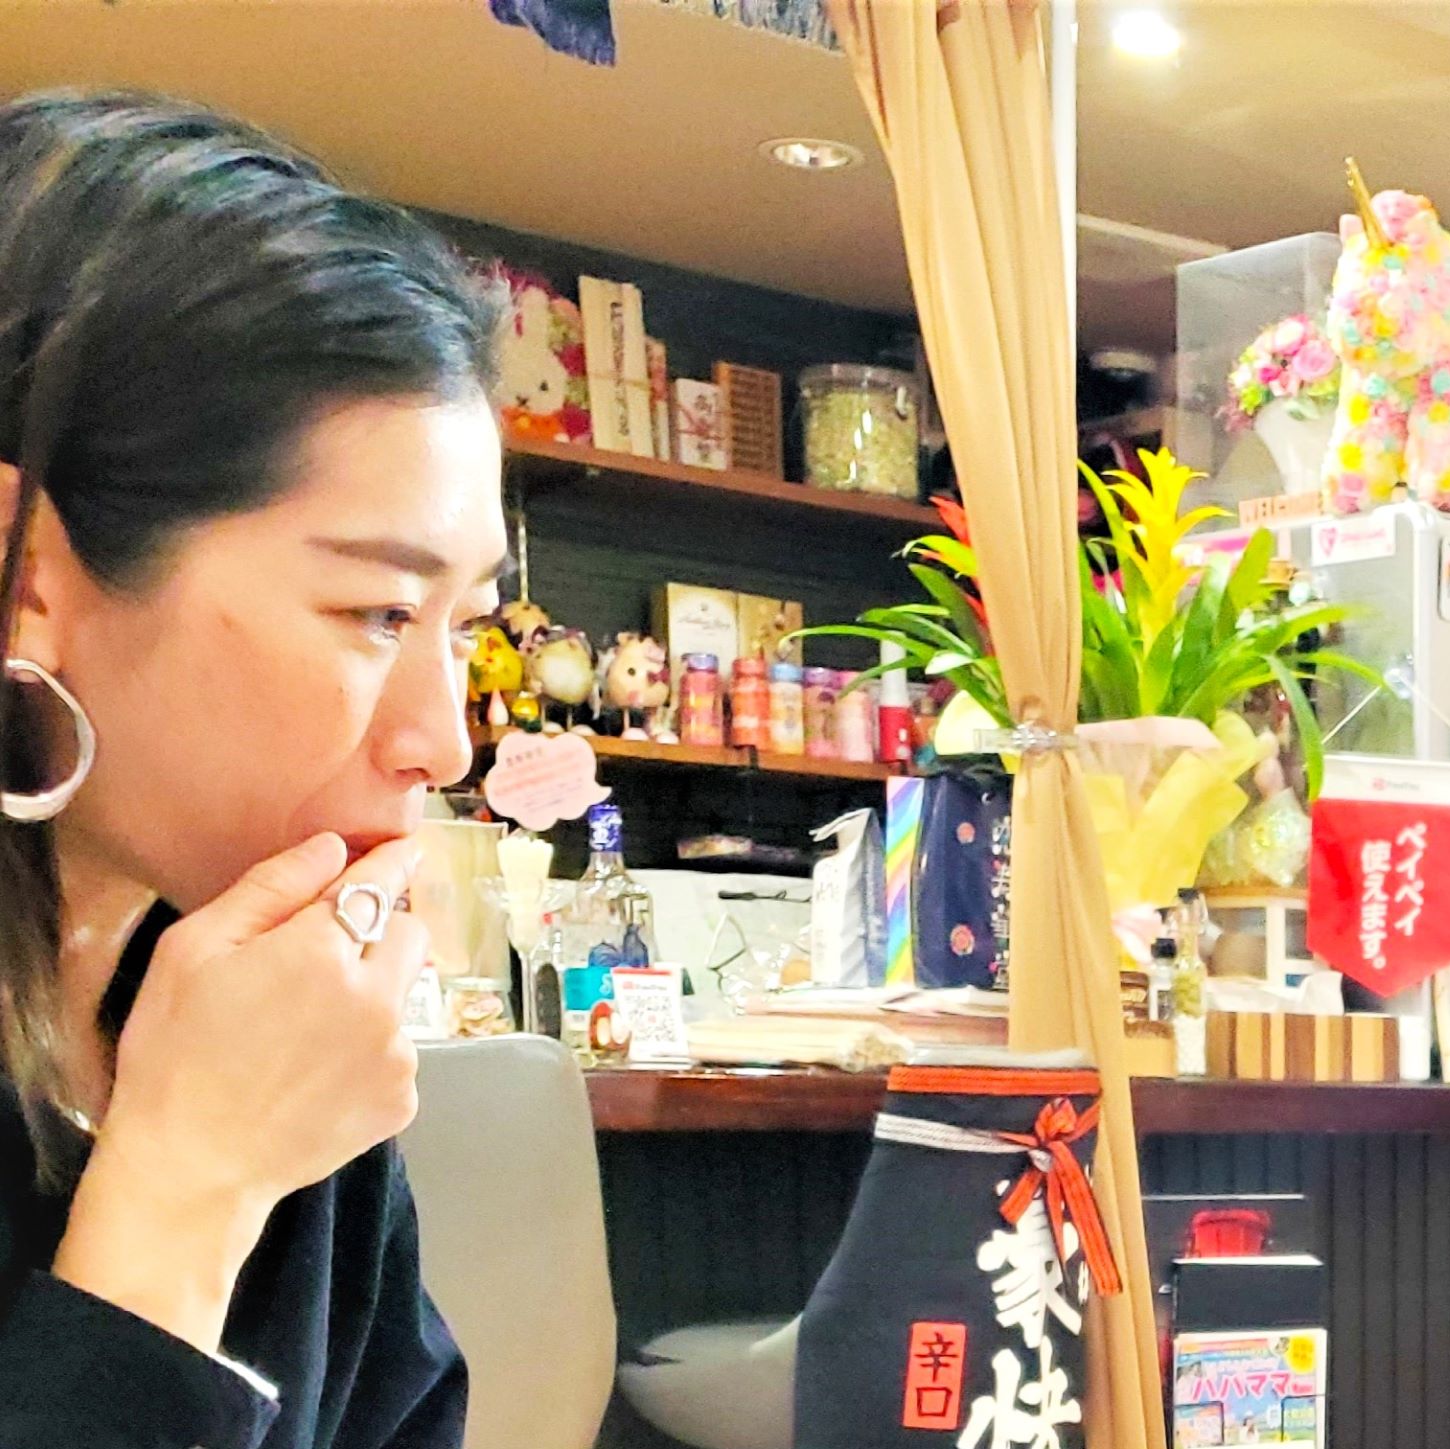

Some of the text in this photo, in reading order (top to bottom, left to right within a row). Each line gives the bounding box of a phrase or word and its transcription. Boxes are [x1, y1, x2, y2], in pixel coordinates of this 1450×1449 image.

[1359, 839, 1393, 970] 使えます。
[1394, 822, 1428, 937] ペイペイ
[914, 1331, 958, 1418] 辛口
